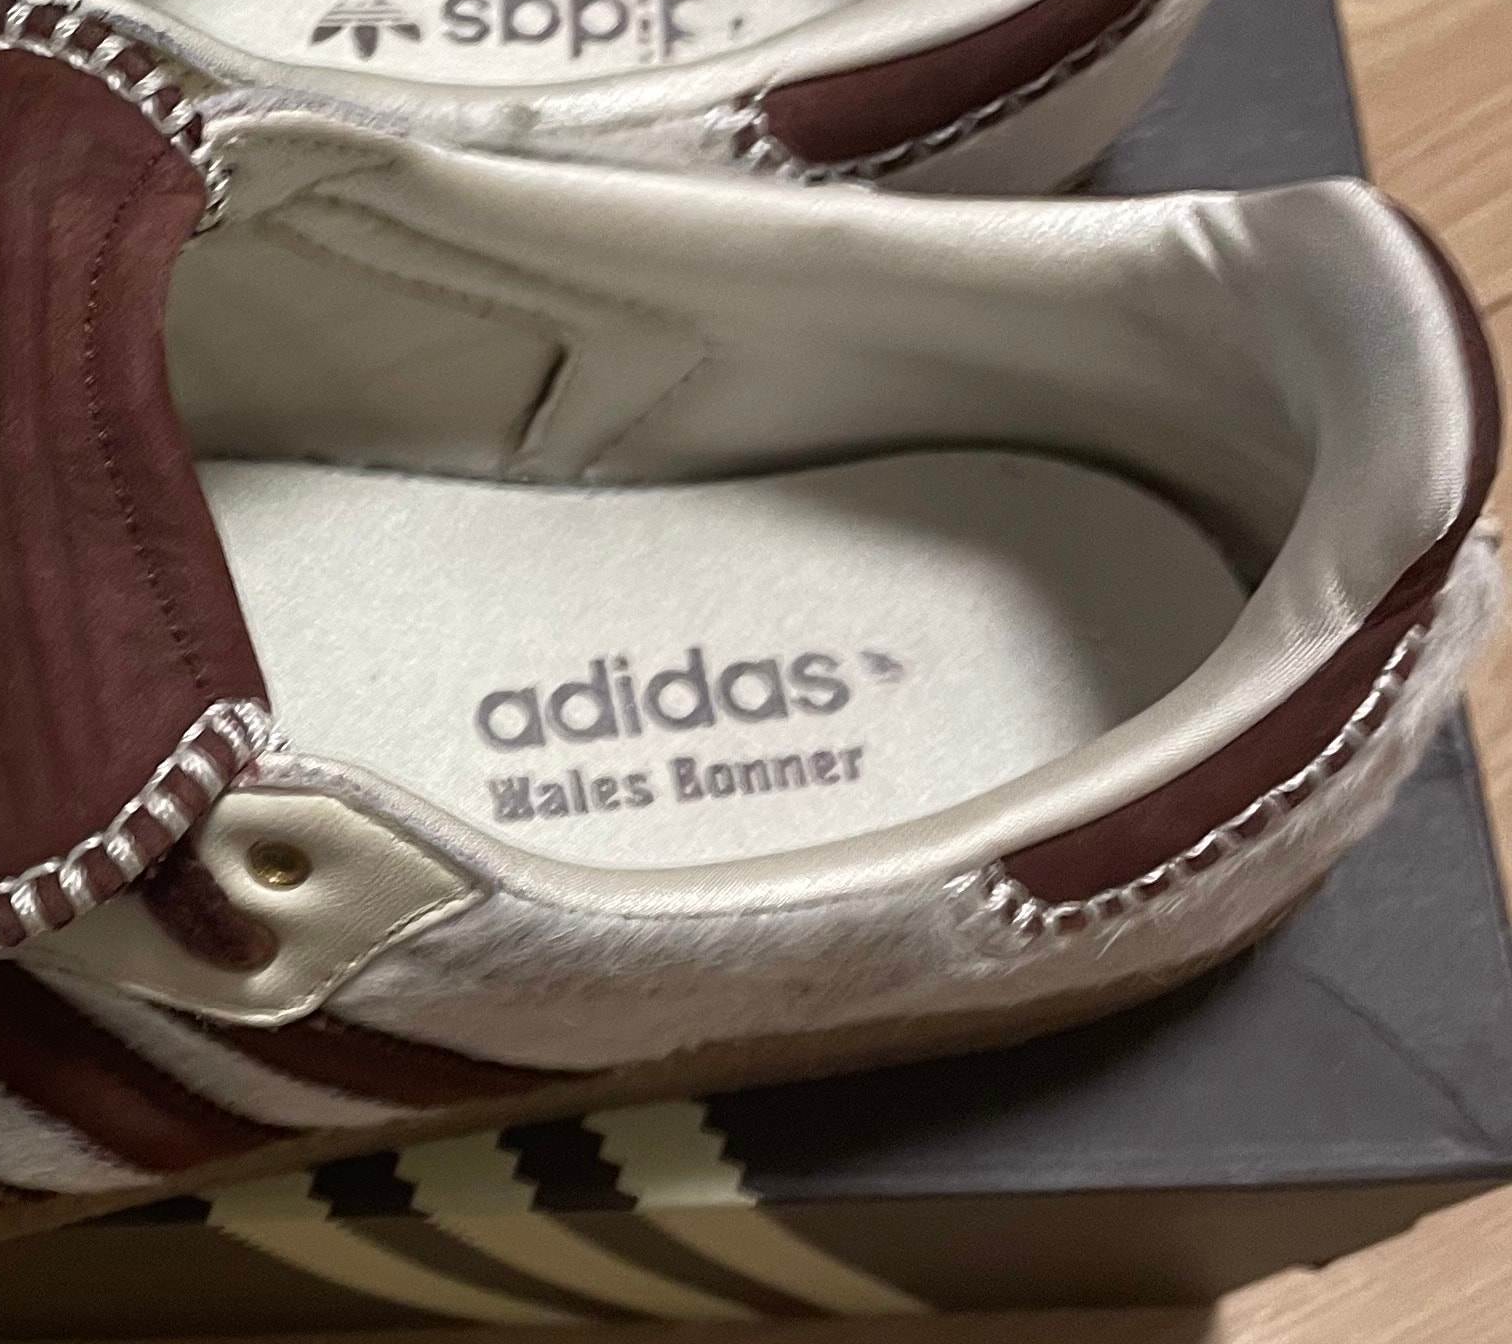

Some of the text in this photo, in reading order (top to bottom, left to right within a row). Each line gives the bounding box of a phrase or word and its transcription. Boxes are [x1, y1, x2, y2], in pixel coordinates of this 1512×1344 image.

[476, 645, 851, 753] adidas
[488, 745, 864, 824] Wales Bonner
